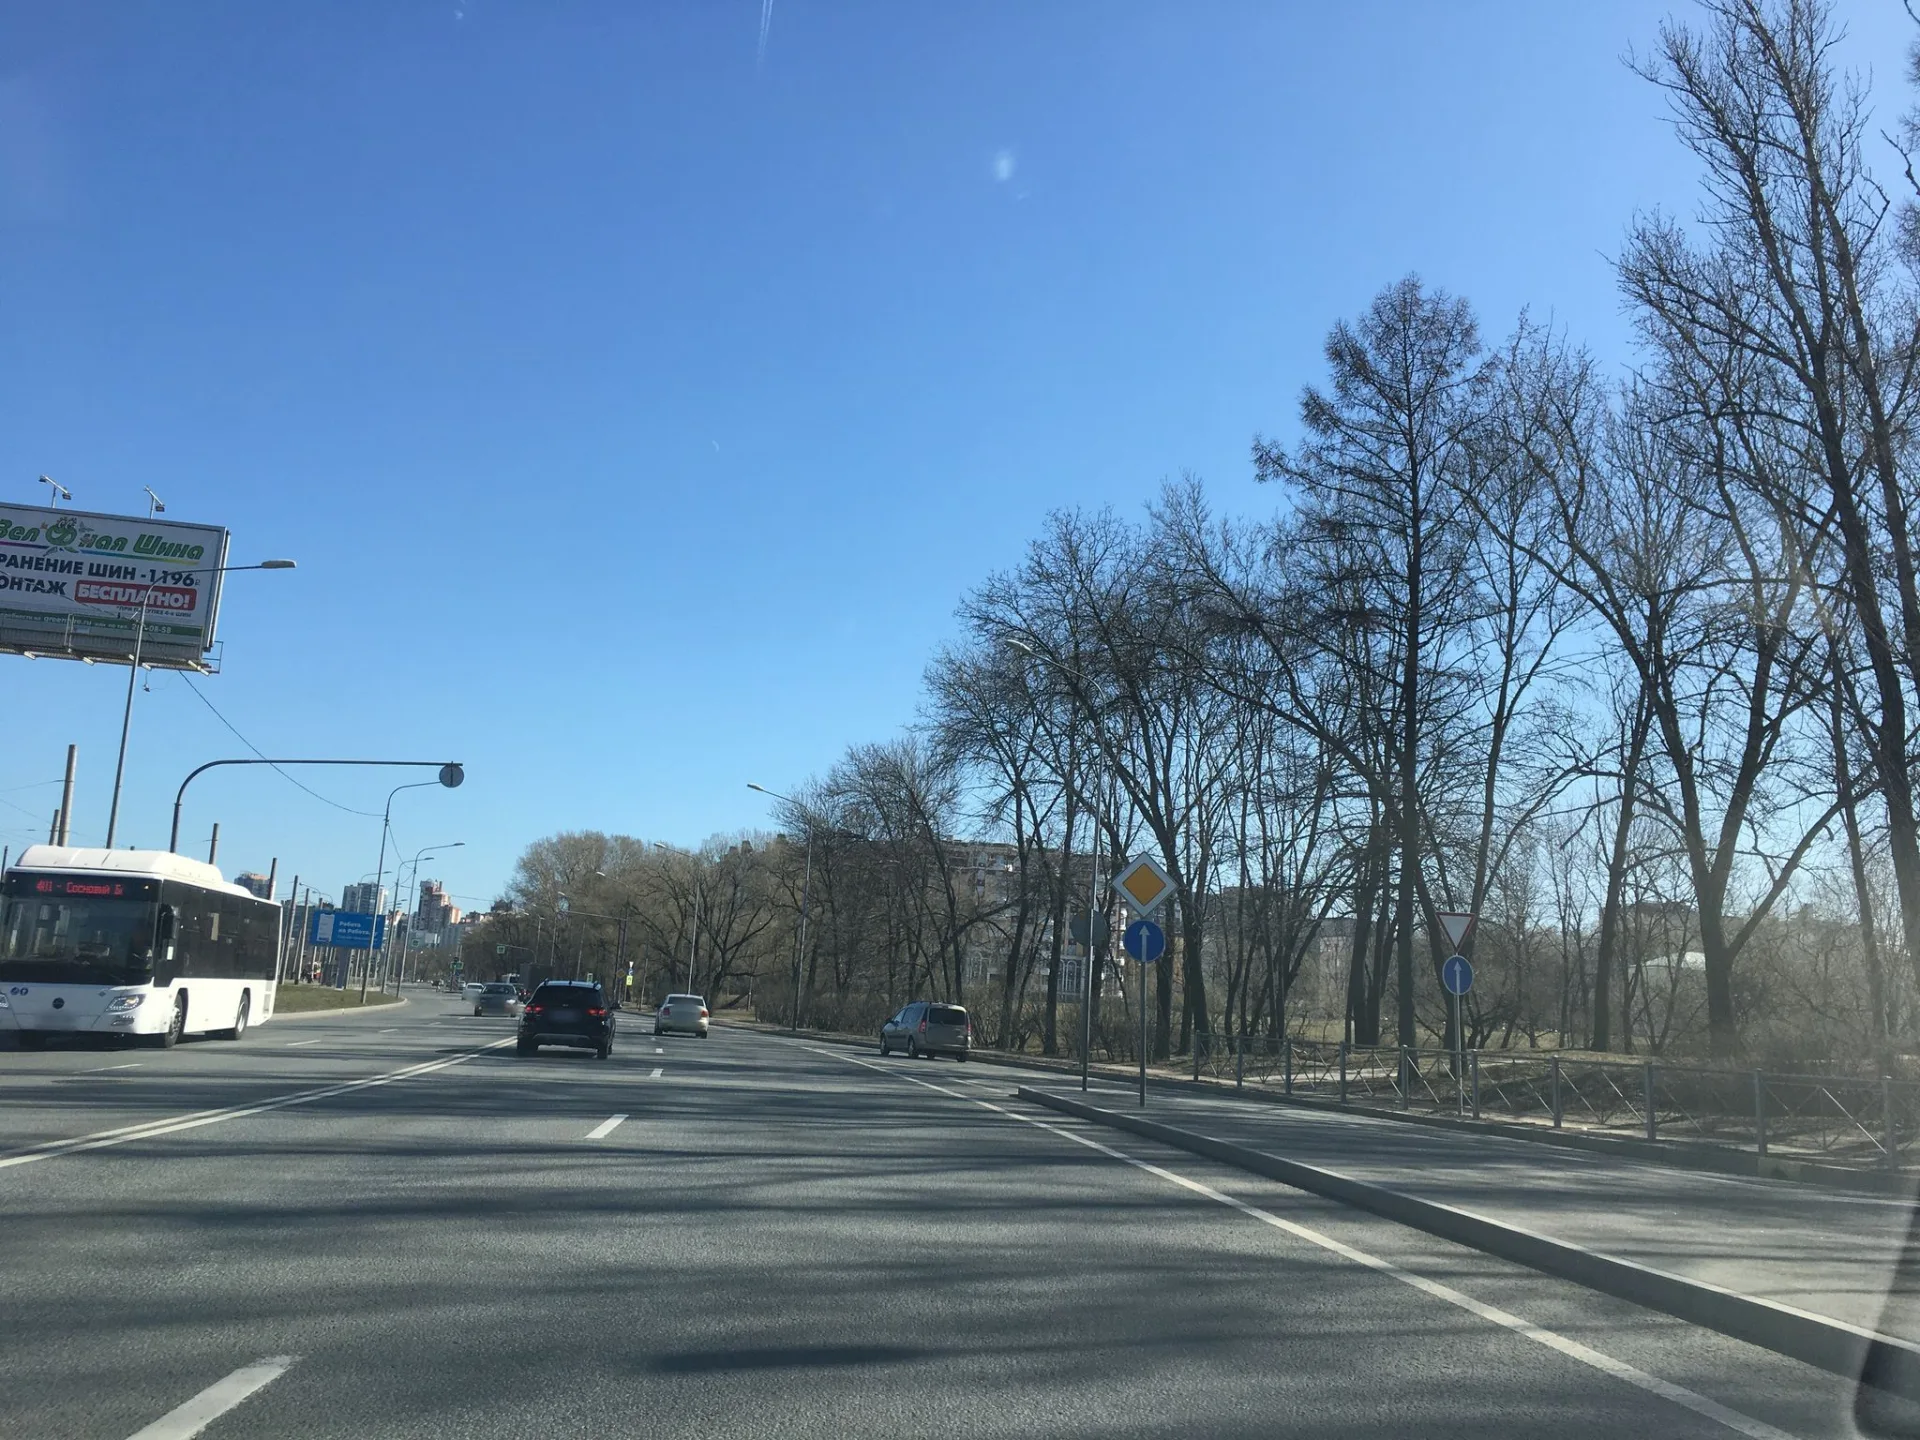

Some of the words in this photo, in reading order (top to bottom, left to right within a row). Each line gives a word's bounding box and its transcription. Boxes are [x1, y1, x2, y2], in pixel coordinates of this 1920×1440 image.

[133, 533, 204, 560] Шина
[88, 562, 137, 581] ШИН
[77, 583, 190, 608] БЕСПЛАТНО!
